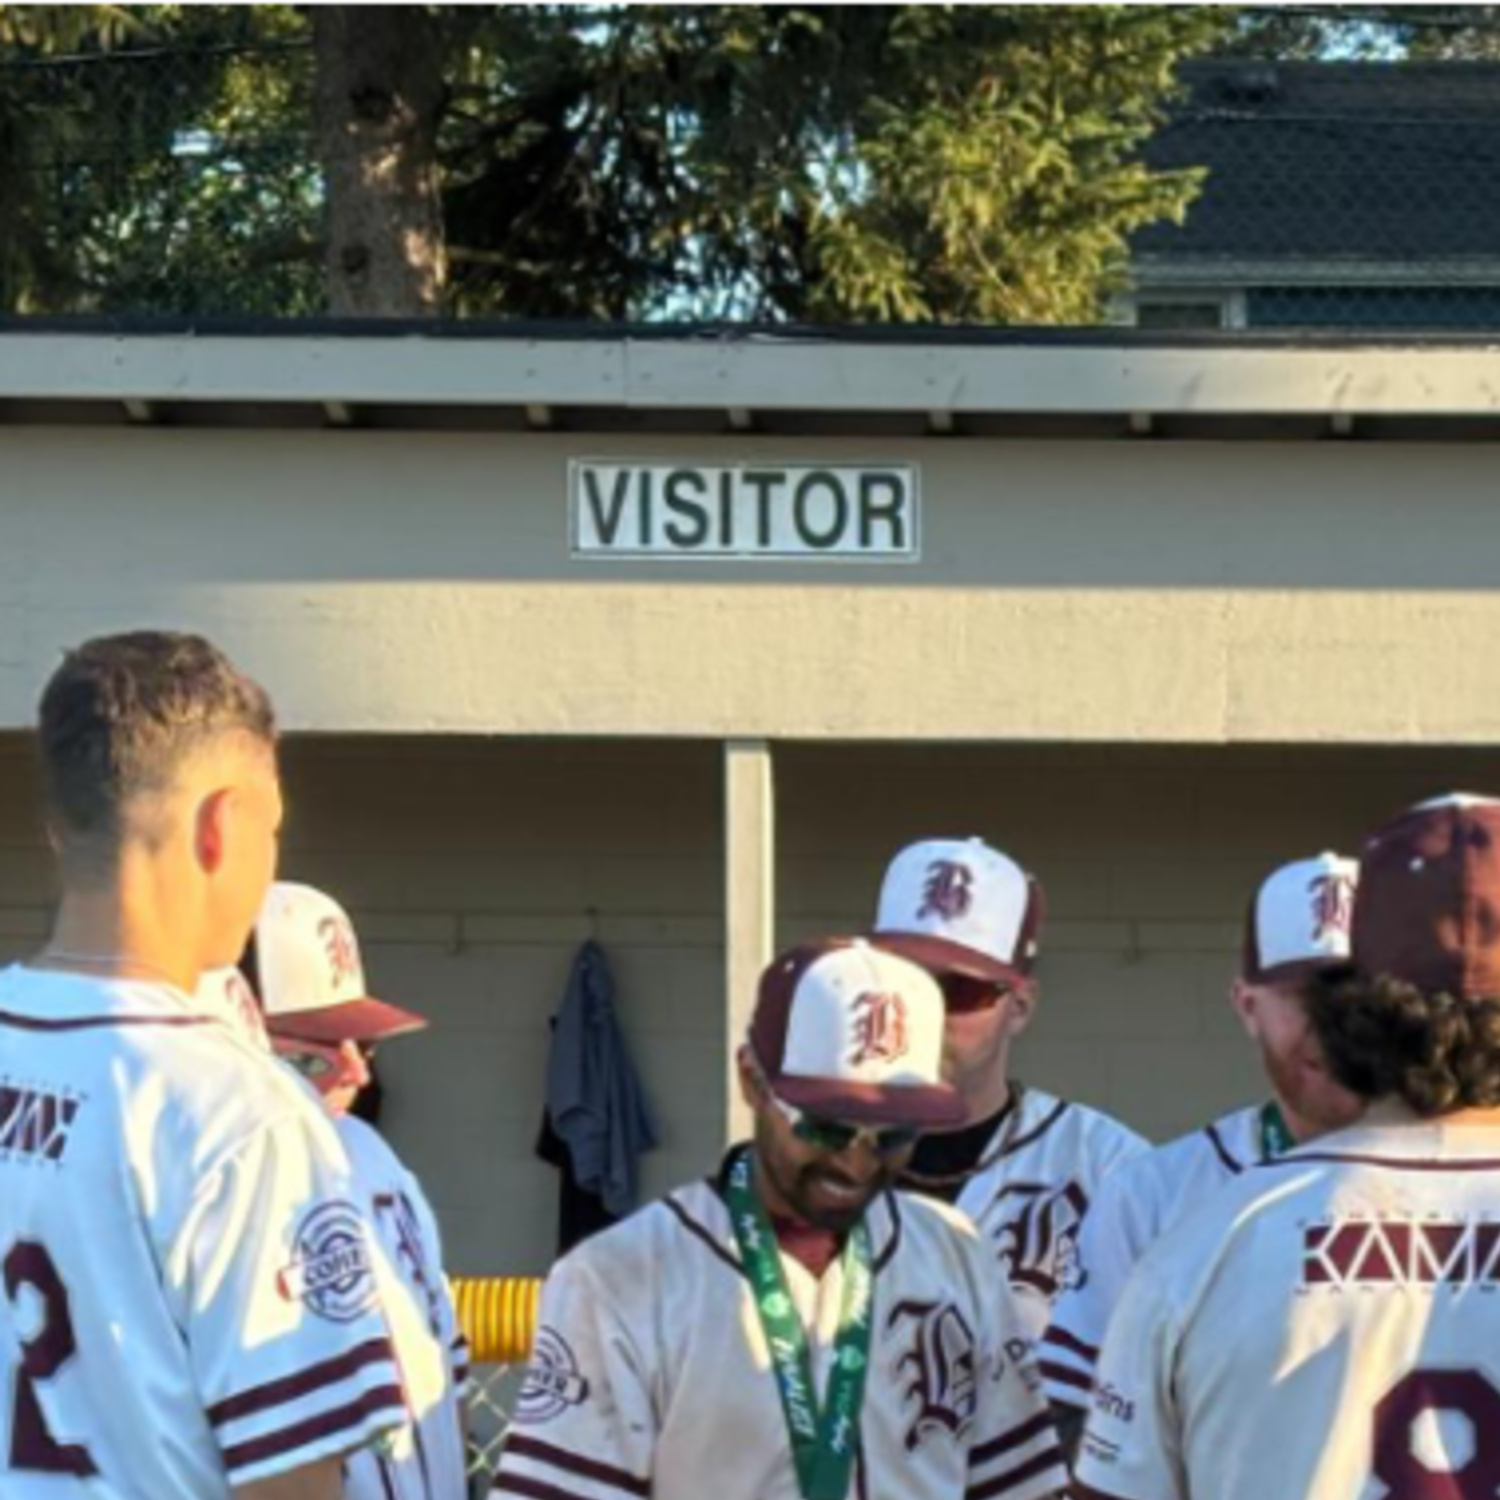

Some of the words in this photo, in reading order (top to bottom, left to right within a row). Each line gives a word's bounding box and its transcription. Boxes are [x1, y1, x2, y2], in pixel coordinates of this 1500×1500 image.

[582, 470, 906, 548] VISITOR
[916, 860, 974, 919] B
[850, 990, 909, 1066] B
[3, 1241, 97, 1475] 2
[886, 1300, 978, 1453] B
